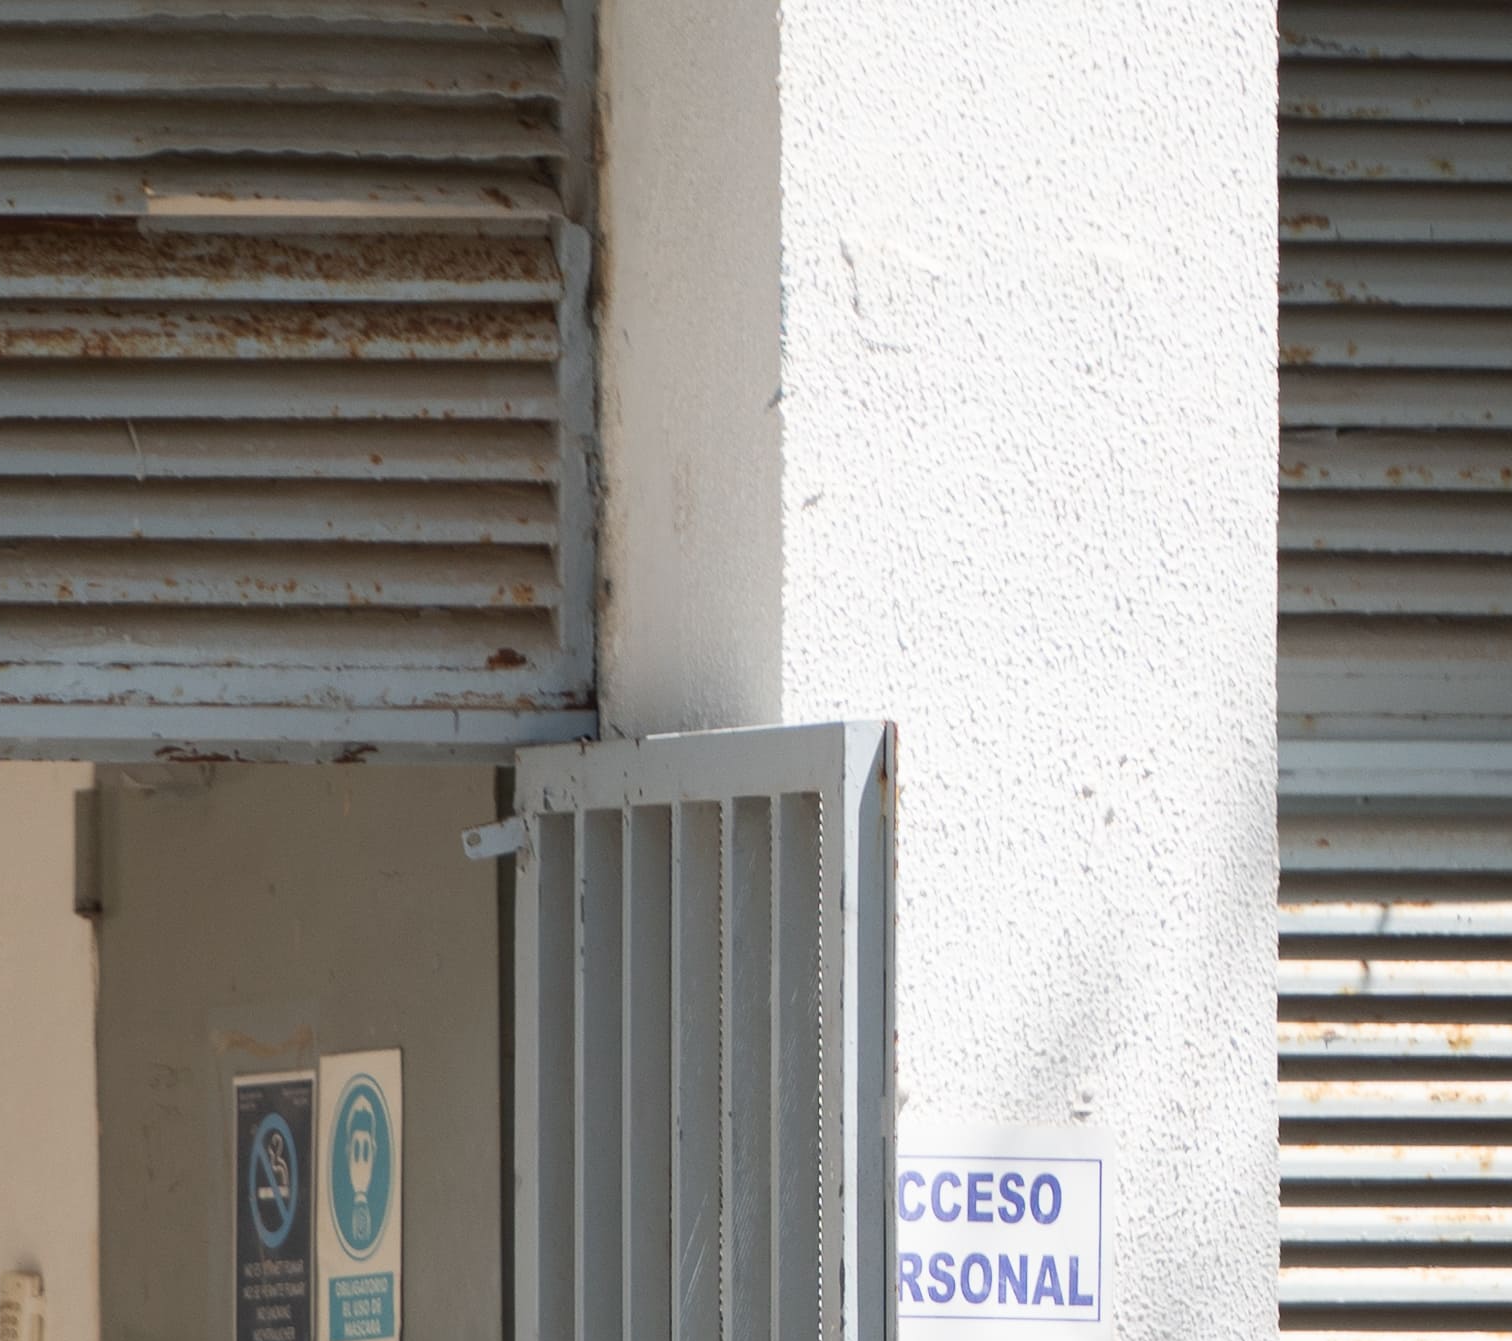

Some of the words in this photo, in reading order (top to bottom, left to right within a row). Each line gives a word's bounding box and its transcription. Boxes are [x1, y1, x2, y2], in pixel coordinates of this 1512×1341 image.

[898, 1170, 1062, 1225] CCESO
[335, 1277, 388, 1297] OBLIGATORIO
[898, 1252, 1094, 1307] RSONAL
